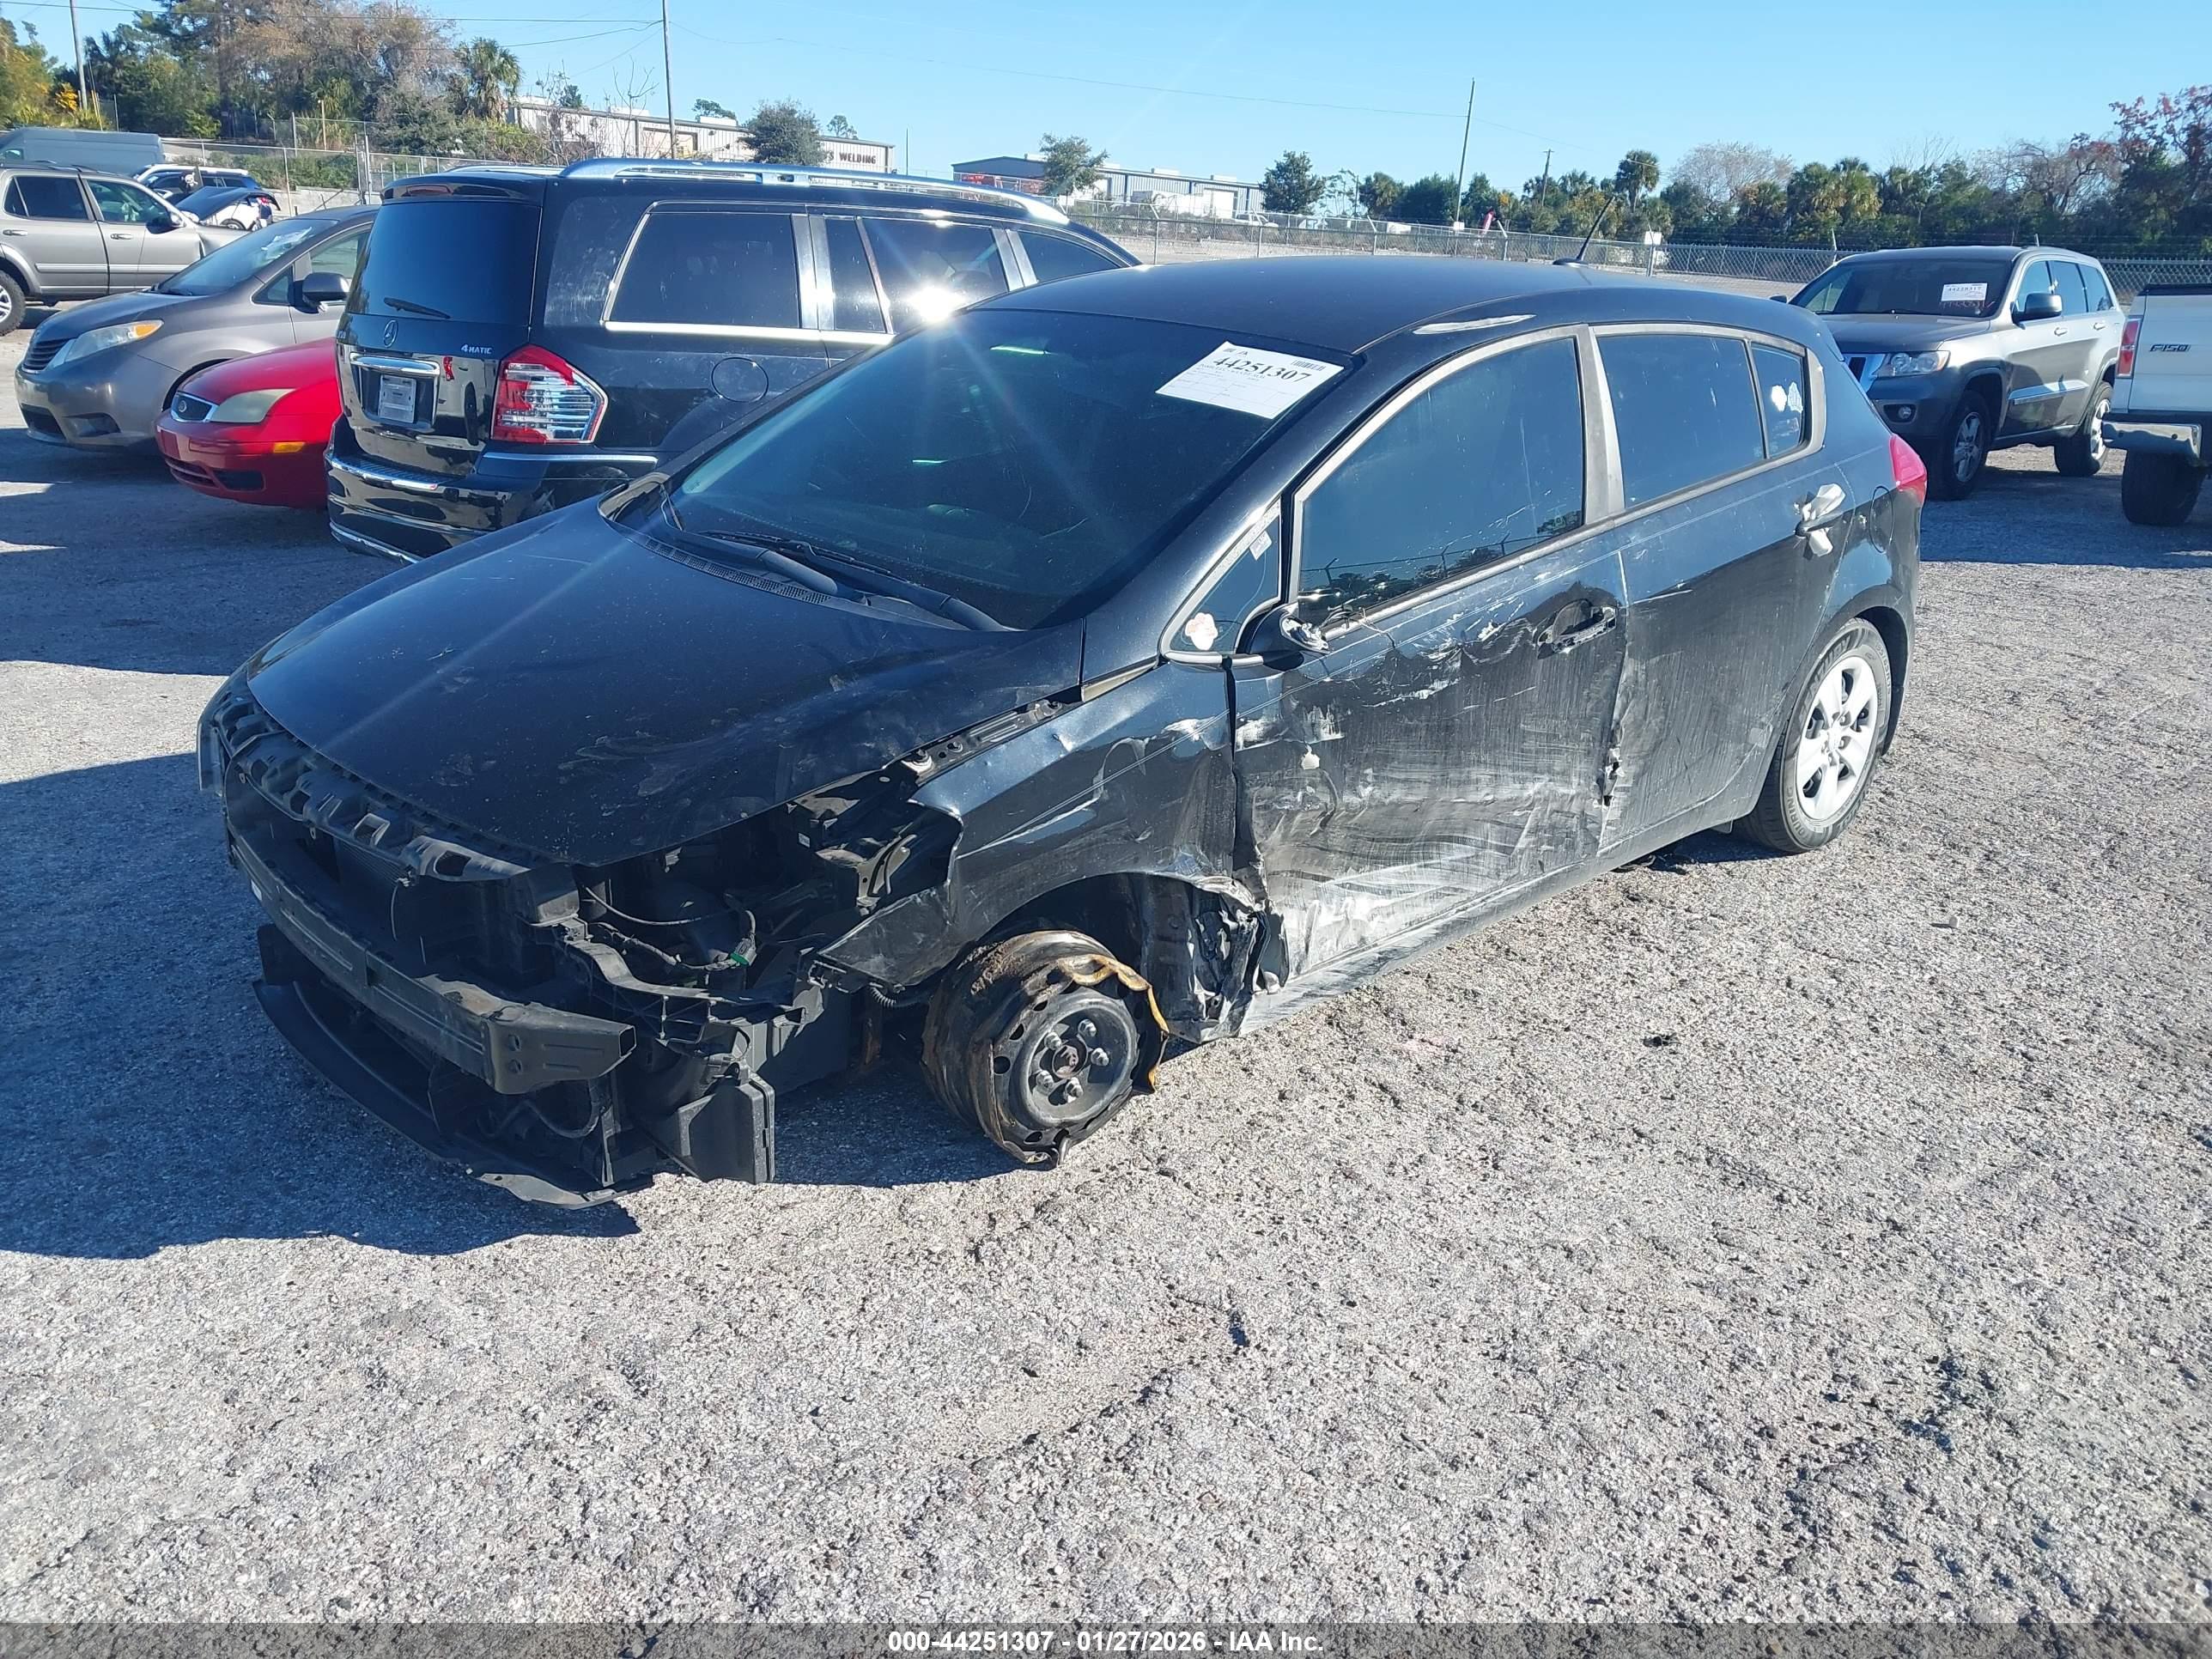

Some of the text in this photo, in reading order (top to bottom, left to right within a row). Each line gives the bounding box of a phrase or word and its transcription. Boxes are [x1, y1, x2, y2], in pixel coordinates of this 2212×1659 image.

[839, 152, 877, 164] WELDING
[460, 344, 494, 355] 4MATIC
[1212, 356, 1312, 383] 44251307
